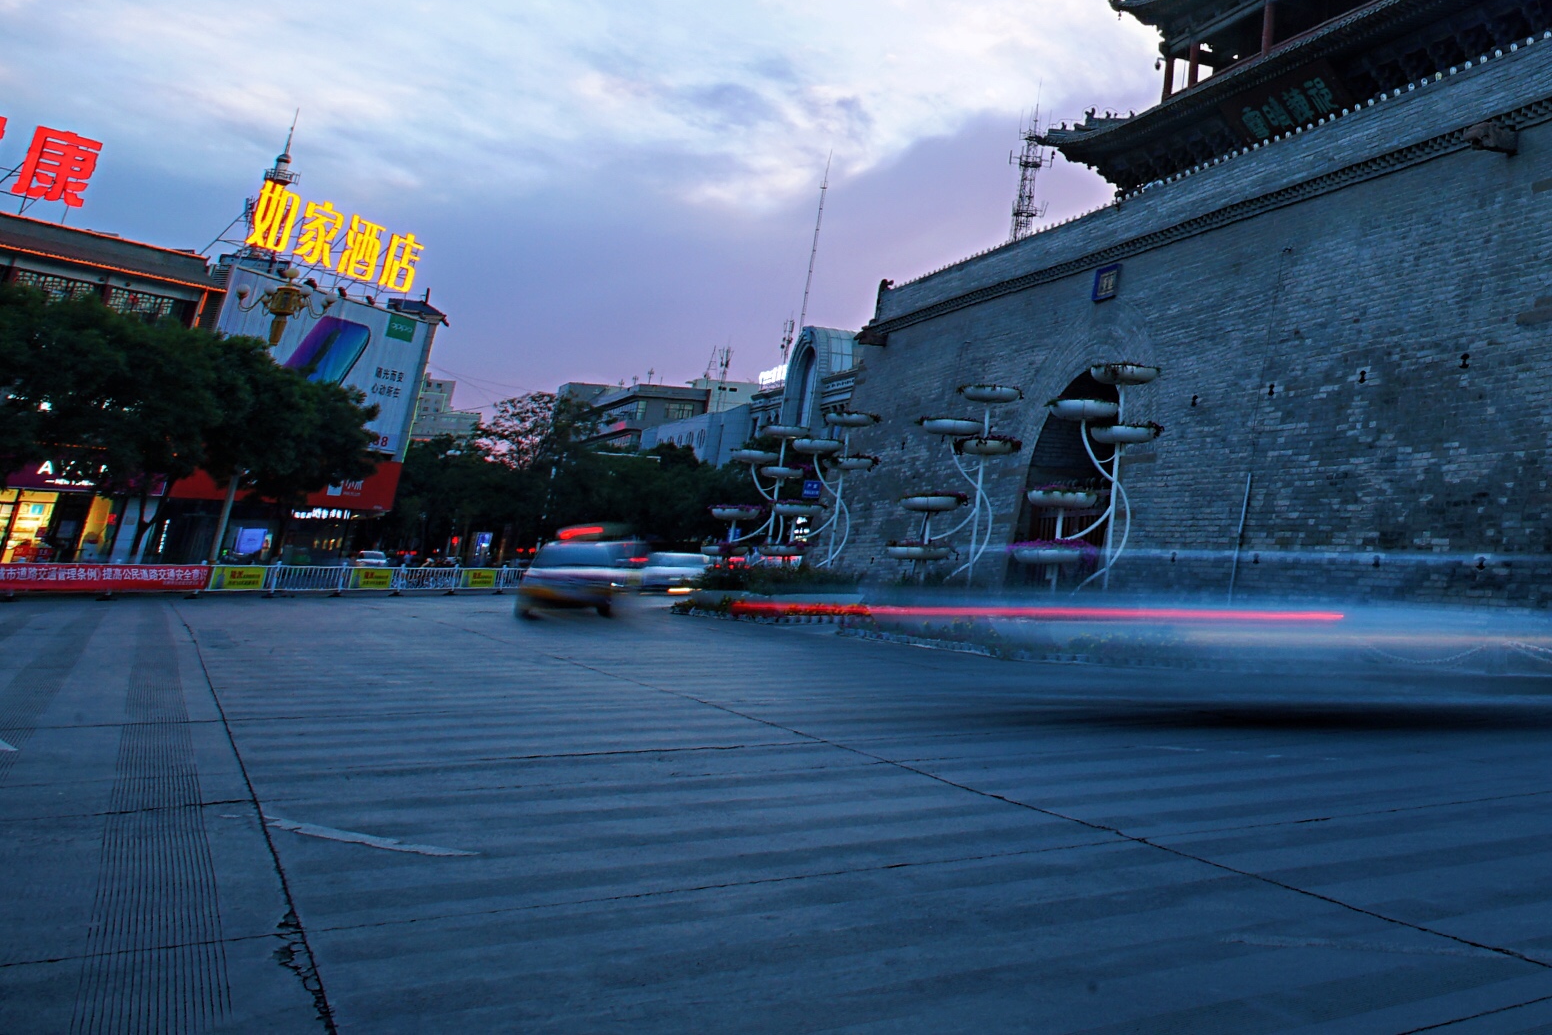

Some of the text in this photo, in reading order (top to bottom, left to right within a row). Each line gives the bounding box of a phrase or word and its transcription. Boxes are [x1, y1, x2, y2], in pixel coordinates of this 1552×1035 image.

[0, 116, 103, 207] 康
[245, 180, 425, 293] 如家酒店
